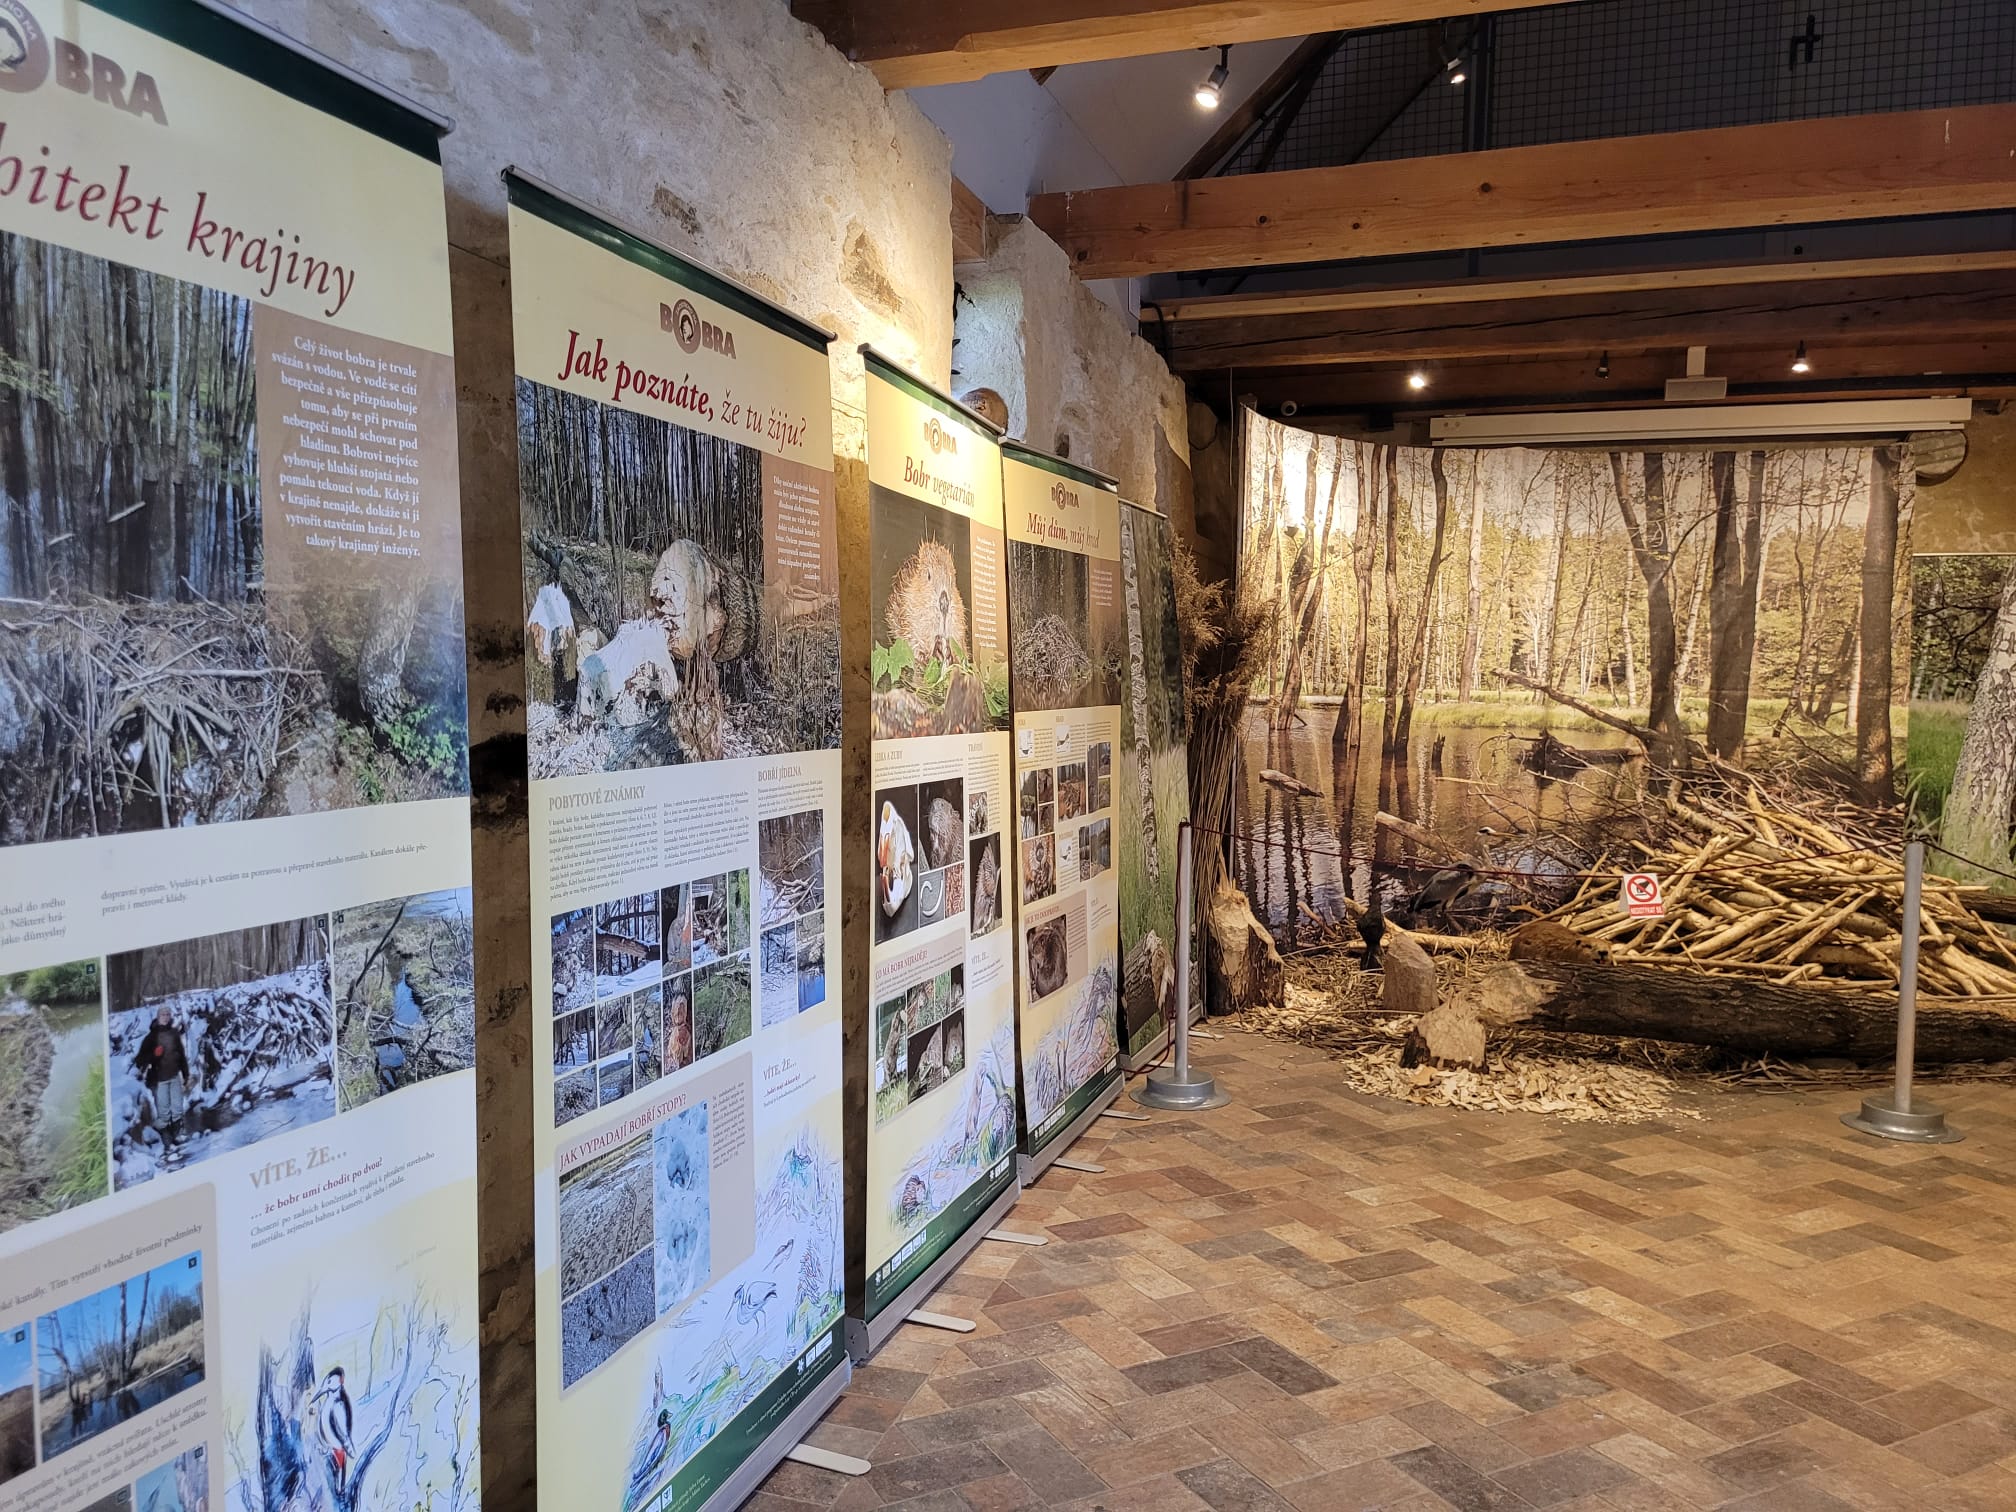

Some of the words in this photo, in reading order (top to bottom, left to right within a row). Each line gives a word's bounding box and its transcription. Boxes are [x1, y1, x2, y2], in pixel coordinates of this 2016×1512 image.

[187, 192, 355, 317] krajiny
[660, 299, 736, 359] BOBRA
[294, 336, 317, 355] Celý
[319, 344, 344, 361] život
[345, 350, 376, 369] bobra
[378, 358, 389, 373] je
[390, 362, 417, 378] trvale
[272, 352, 304, 369] svázán
[306, 361, 311, 371] s
[313, 362, 346, 381] vodou.
[348, 370, 361, 384] Ve
[402, 382, 417, 396] cítí
[281, 372, 326, 395] bezpečně
[328, 388, 333, 396] a
[335, 387, 351, 400] vše
[353, 391, 418, 414] přizpůsobuje
[558, 330, 608, 382] Jak
[612, 361, 714, 422] poznáte,
[721, 390, 740, 425] že
[746, 404, 763, 433] tu
[768, 407, 807, 453] žiju?
[301, 399, 330, 416] tomu,
[332, 404, 350, 420] aby
[352, 412, 362, 421] se
[364, 410, 380, 424] při
[382, 417, 417, 432] prvním
[283, 414, 329, 435] nebezpečí
[331, 425, 357, 440] mohl
[360, 431, 397, 447] schovat
[399, 438, 418, 451] pod
[300, 434, 340, 455] hladinu.
[343, 444, 382, 462] Bobrovi
[385, 452, 419, 468] nejvíce
[283, 453, 326, 471] vyhovuje
[328, 460, 358, 476] hlubší
[360, 467, 393, 482] stojatá
[395, 473, 419, 486] nebo
[904, 456, 930, 489] Bobr
[280, 473, 315, 489] pomalu
[318, 479, 354, 494] tekoucí
[356, 487, 382, 499] voda.
[384, 487, 410, 504] Když
[280, 493, 286, 502] v
[288, 490, 321, 509] krajině
[323, 498, 363, 516] nenajde,
[366, 504, 400, 519] dokáže
[402, 509, 410, 520] si
[286, 513, 321, 529] vytvořit
[323, 518, 365, 533] stavěním
[397, 525, 408, 539] Je
[410, 528, 420, 539] to
[1026, 513, 1046, 543] Můj
[1048, 517, 1068, 544] dům,
[1070, 526, 1084, 551] můj
[306, 533, 337, 549] takový
[339, 537, 380, 554] krajinný
[382, 543, 421, 557] inženýr.
[549, 788, 601, 811] POBYTOVÉ
[604, 785, 645, 803] ZNÁMKY
[27, 902, 38, 912] do
[24, 926, 66, 941] důmyslný
[560, 1146, 577, 1171] JAK
[580, 1121, 627, 1156] VYPADAJÍ
[630, 1107, 655, 1133] BOBŘÍ
[657, 1094, 687, 1118] STOPY?
[249, 1158, 301, 1189] VÍTE,
[265, 1204, 274, 1214] že
[277, 1194, 300, 1208] bobr
[303, 1184, 320, 1199] umí
[323, 1173, 349, 1191] chodit
[352, 1170, 361, 1182] po
[364, 1156, 382, 1174] dvou?
[164, 1224, 202, 1247] podmínky
[282, 1217, 291, 1227] po
